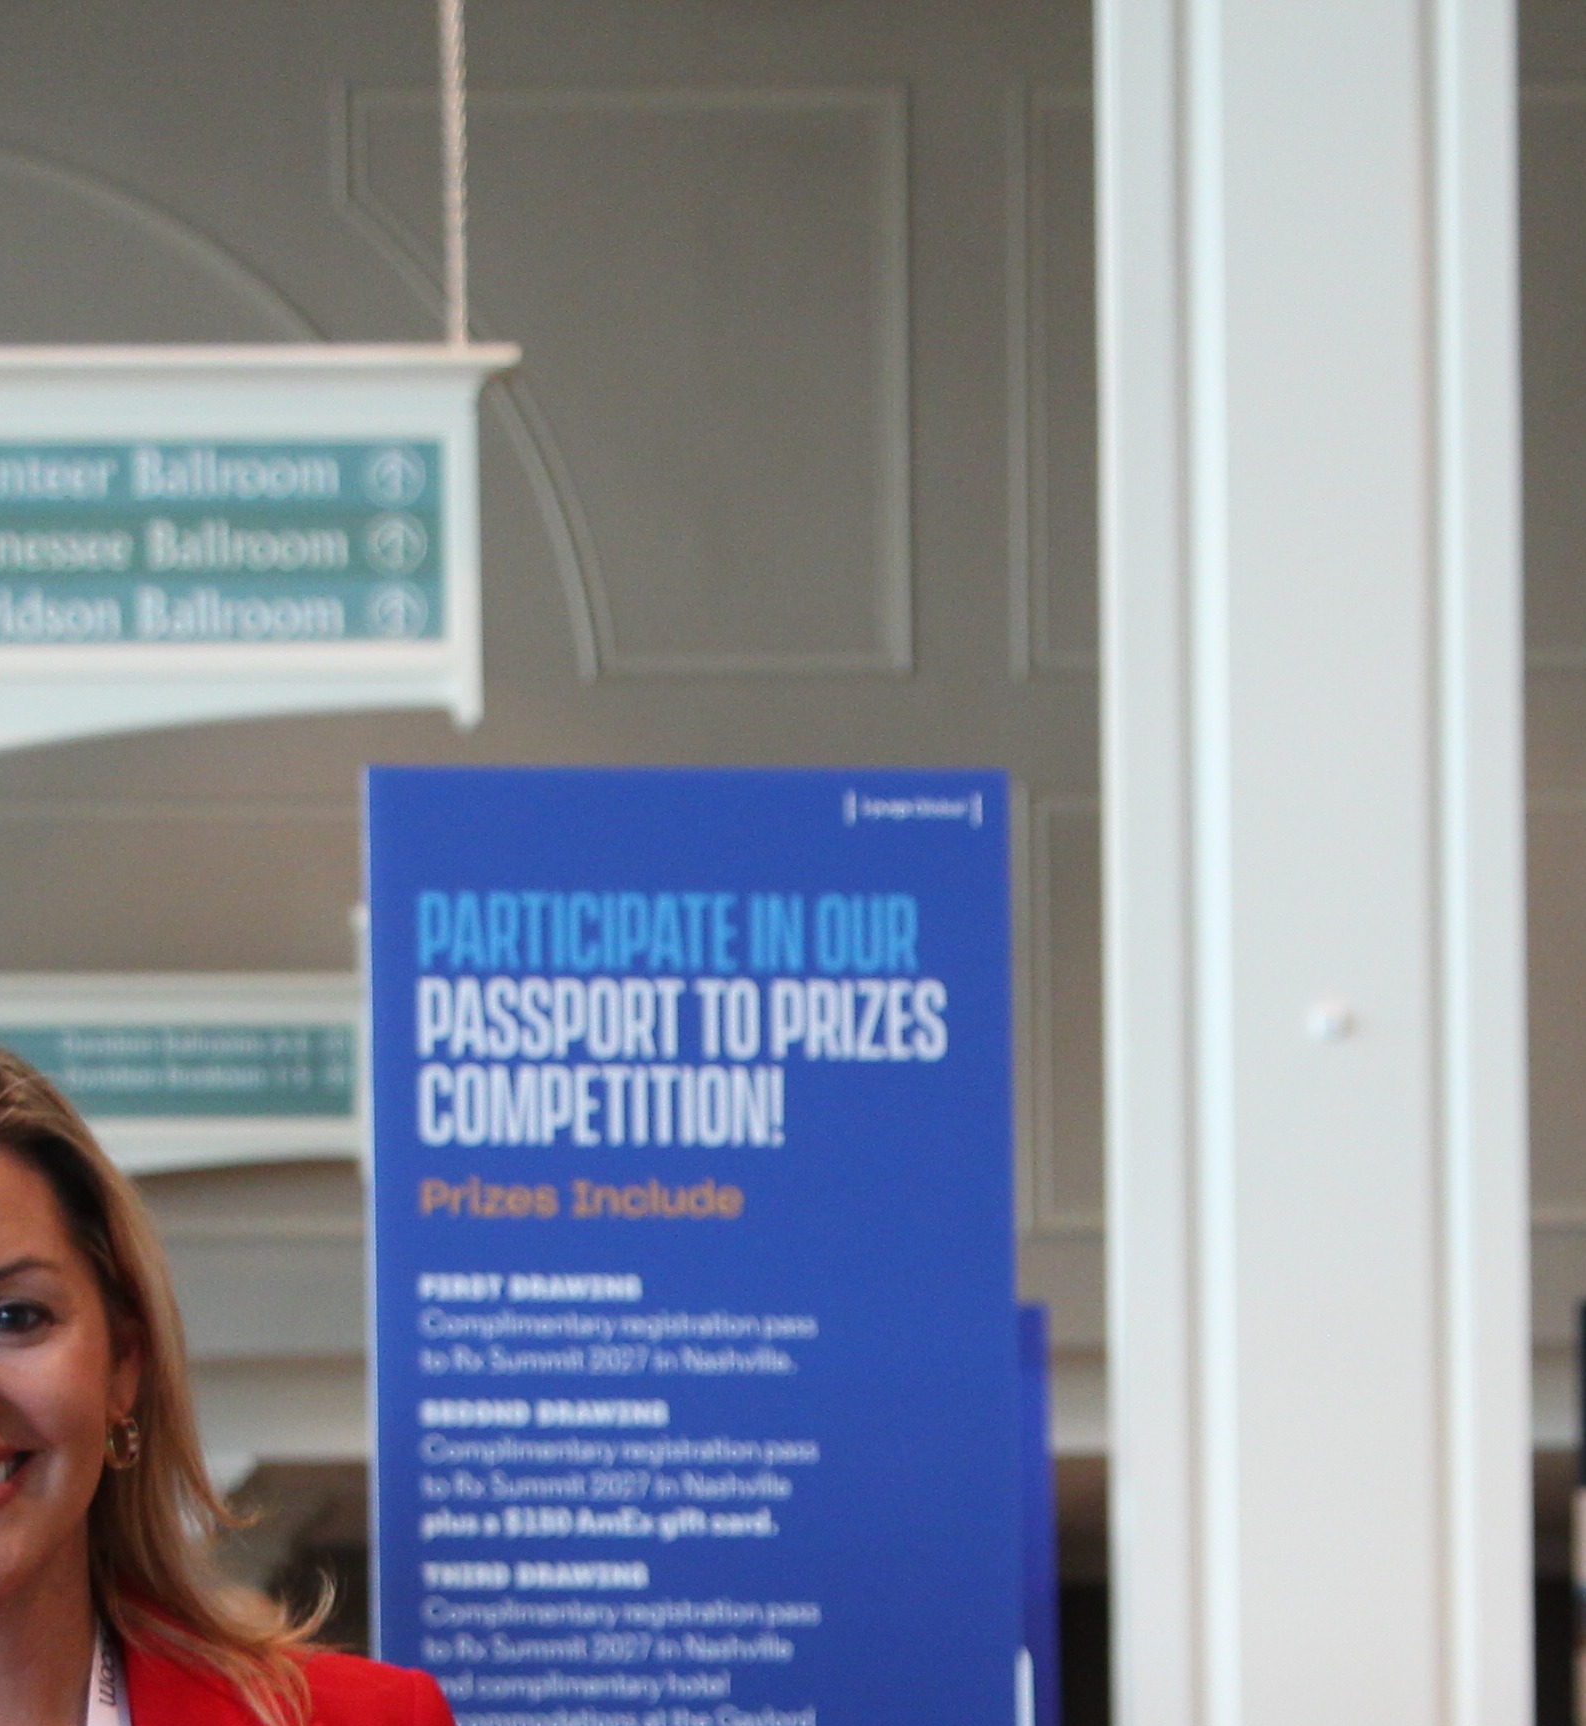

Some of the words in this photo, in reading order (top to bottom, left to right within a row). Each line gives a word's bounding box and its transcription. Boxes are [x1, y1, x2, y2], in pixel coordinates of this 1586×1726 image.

[131, 448, 340, 499] Ballroom
[144, 518, 349, 570] Ballroom
[134, 587, 344, 640] Ballroom
[417, 890, 739, 973] PARTICIPATE
[749, 891, 805, 973] IN
[816, 892, 917, 973] OUR
[416, 976, 685, 1061] PASSPORT
[695, 977, 760, 1061] TO
[770, 977, 947, 1062] PRIZES
[416, 1063, 786, 1148] COMPETITION!
[420, 1177, 559, 1219] Prizes
[572, 1177, 743, 1219] Include
[421, 1307, 613, 1341] Complimentary
[488, 1345, 585, 1375] Summit
[422, 1432, 614, 1466] Complimentary
[489, 1470, 585, 1499] Summit
[423, 1594, 616, 1628] Complimentary
[490, 1632, 587, 1662] Summit
